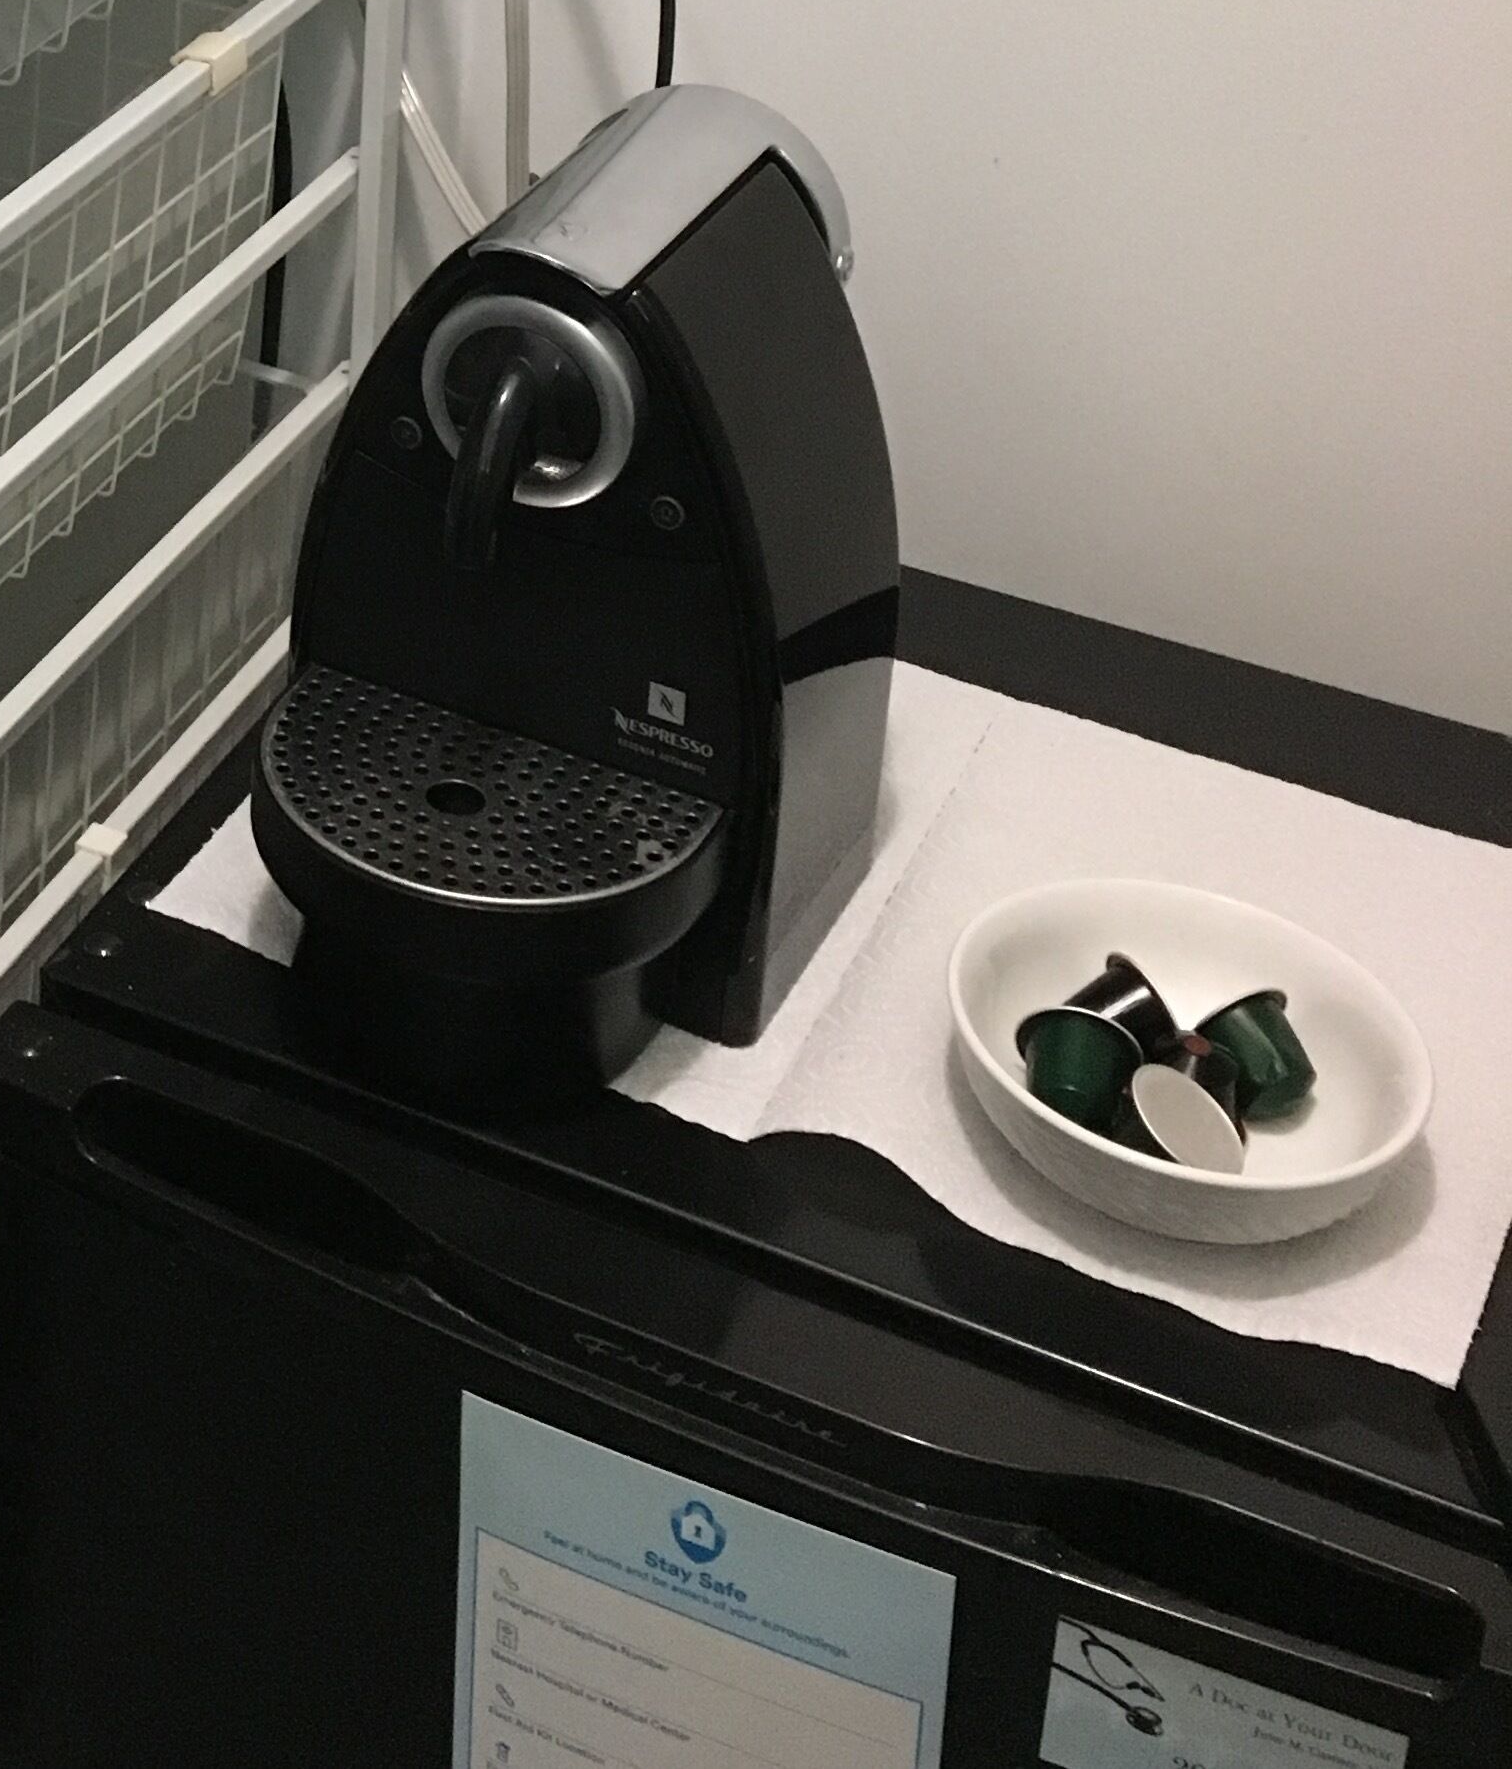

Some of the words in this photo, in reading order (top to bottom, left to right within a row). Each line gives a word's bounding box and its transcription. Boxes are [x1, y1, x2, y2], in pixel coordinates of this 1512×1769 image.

[610, 706, 714, 758] NESPRESSO
[644, 1550, 692, 1583] Stay
[699, 1572, 748, 1603] Safe
[730, 1608, 758, 1623] your
[1188, 1682, 1204, 1698] A
[1211, 1688, 1249, 1713] Doc
[1283, 1713, 1333, 1742] Your
